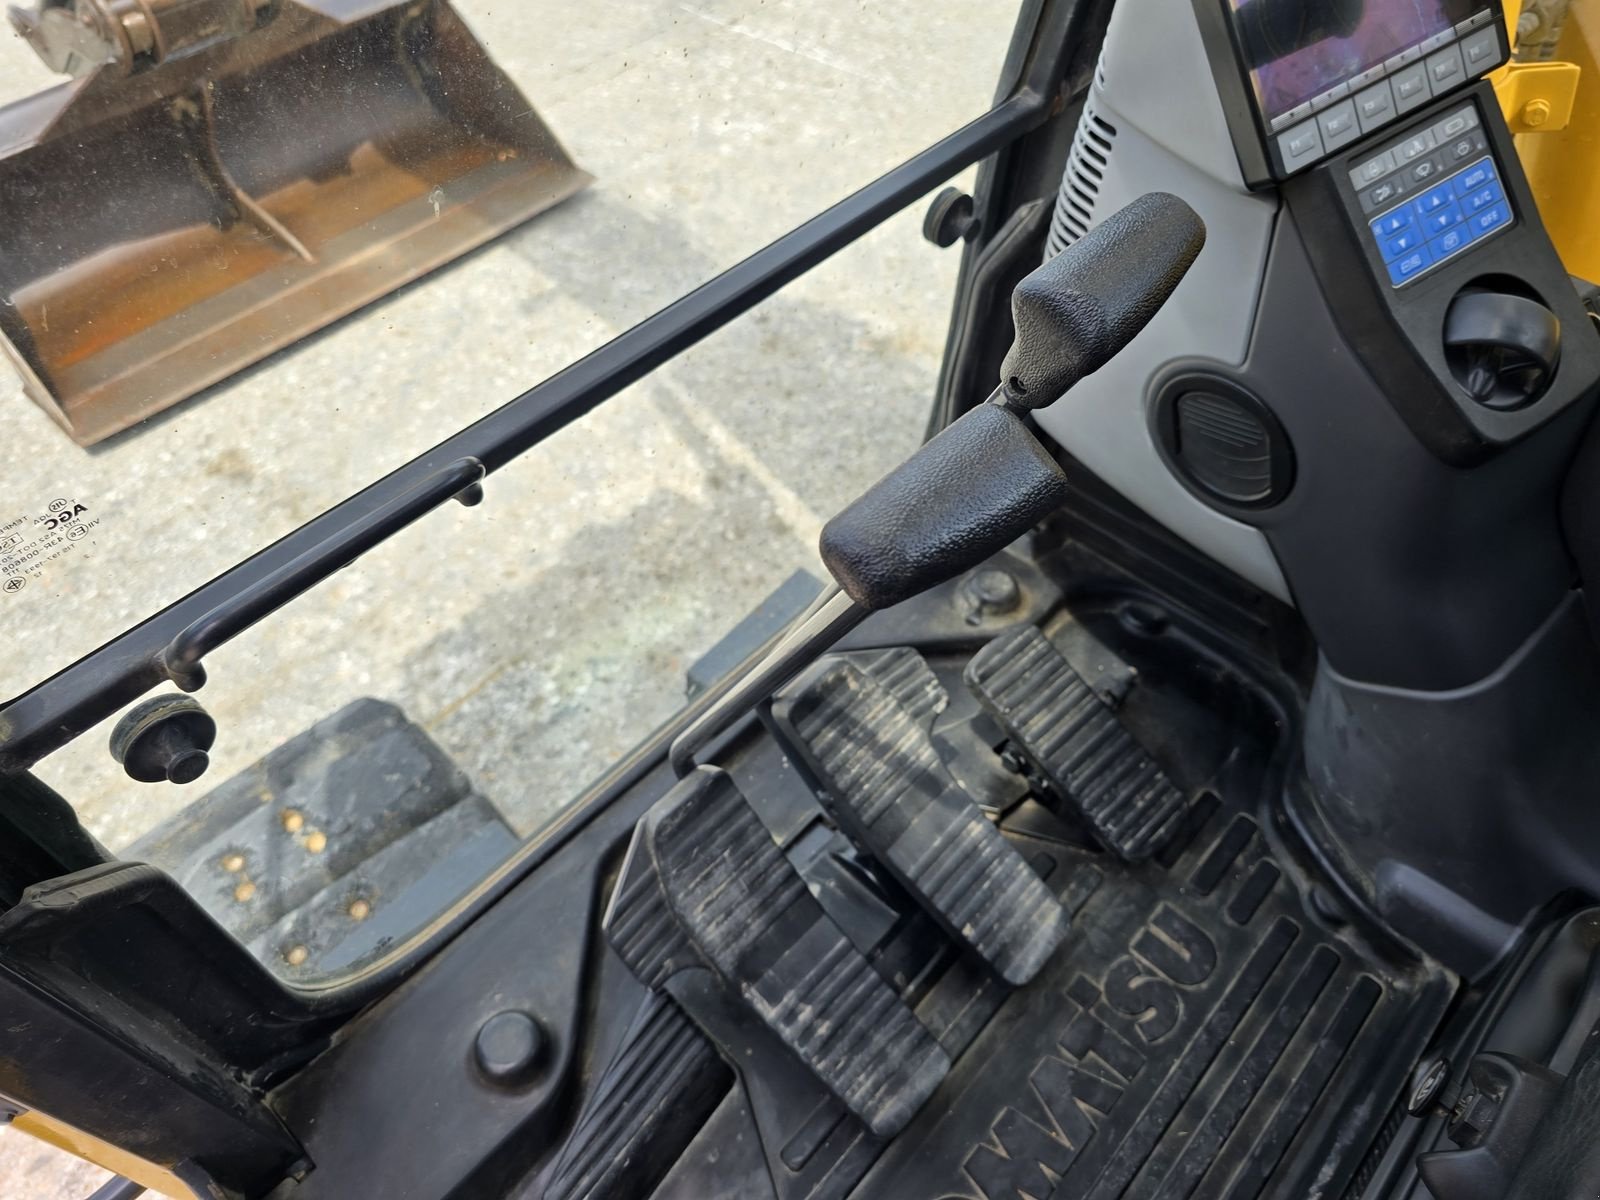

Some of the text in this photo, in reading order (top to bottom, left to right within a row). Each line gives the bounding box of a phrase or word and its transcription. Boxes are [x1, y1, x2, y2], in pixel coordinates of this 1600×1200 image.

[1465, 169, 1486, 187] AUTO
[1473, 190, 1492, 207] A/C
[1480, 210, 1499, 227] OFF
[930, 900, 1217, 1200] MATSU
